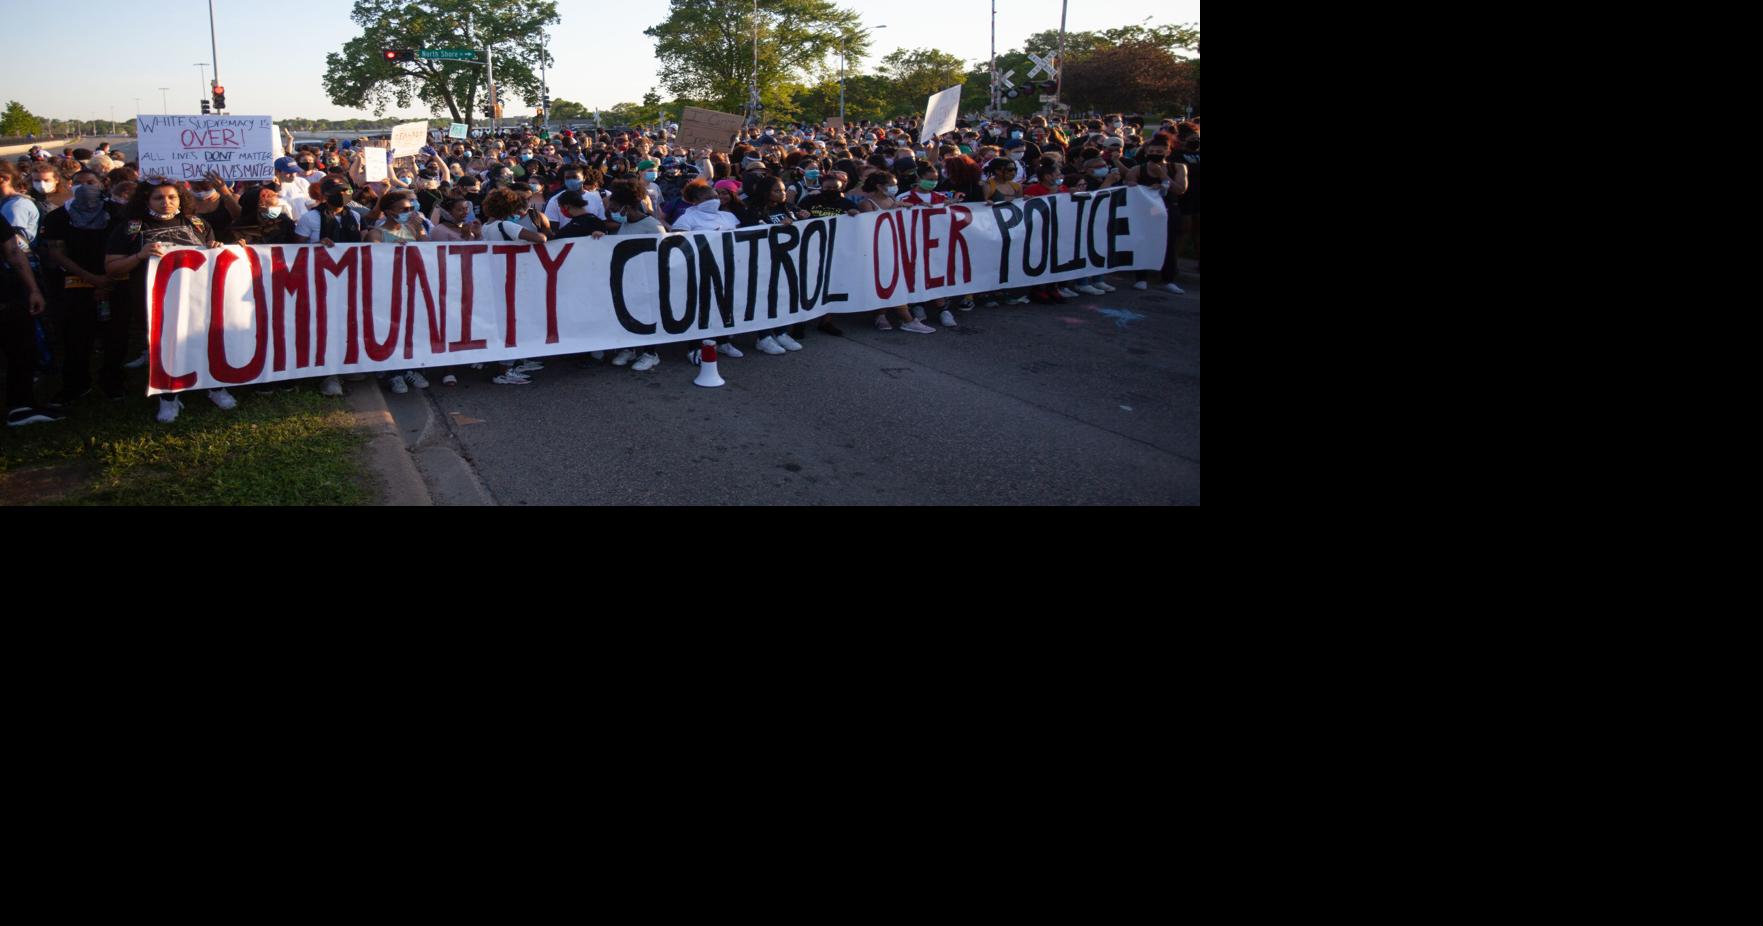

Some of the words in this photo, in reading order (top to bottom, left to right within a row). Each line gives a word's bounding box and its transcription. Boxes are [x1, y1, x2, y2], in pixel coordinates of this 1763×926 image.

[421, 50, 439, 58] North
[441, 50, 458, 58] Shore
[139, 116, 186, 133] WHITE
[181, 128, 246, 147] OVER!
[141, 152, 164, 161] ALL
[172, 151, 198, 160] LIVES
[238, 151, 273, 161] MATTER
[181, 163, 214, 179] BLACK
[243, 163, 274, 178] MATTER
[151, 242, 574, 390] COMMUNITY
[610, 217, 848, 335] CONTROL
[873, 204, 972, 300] OVER
[992, 187, 1134, 284] POLICE
